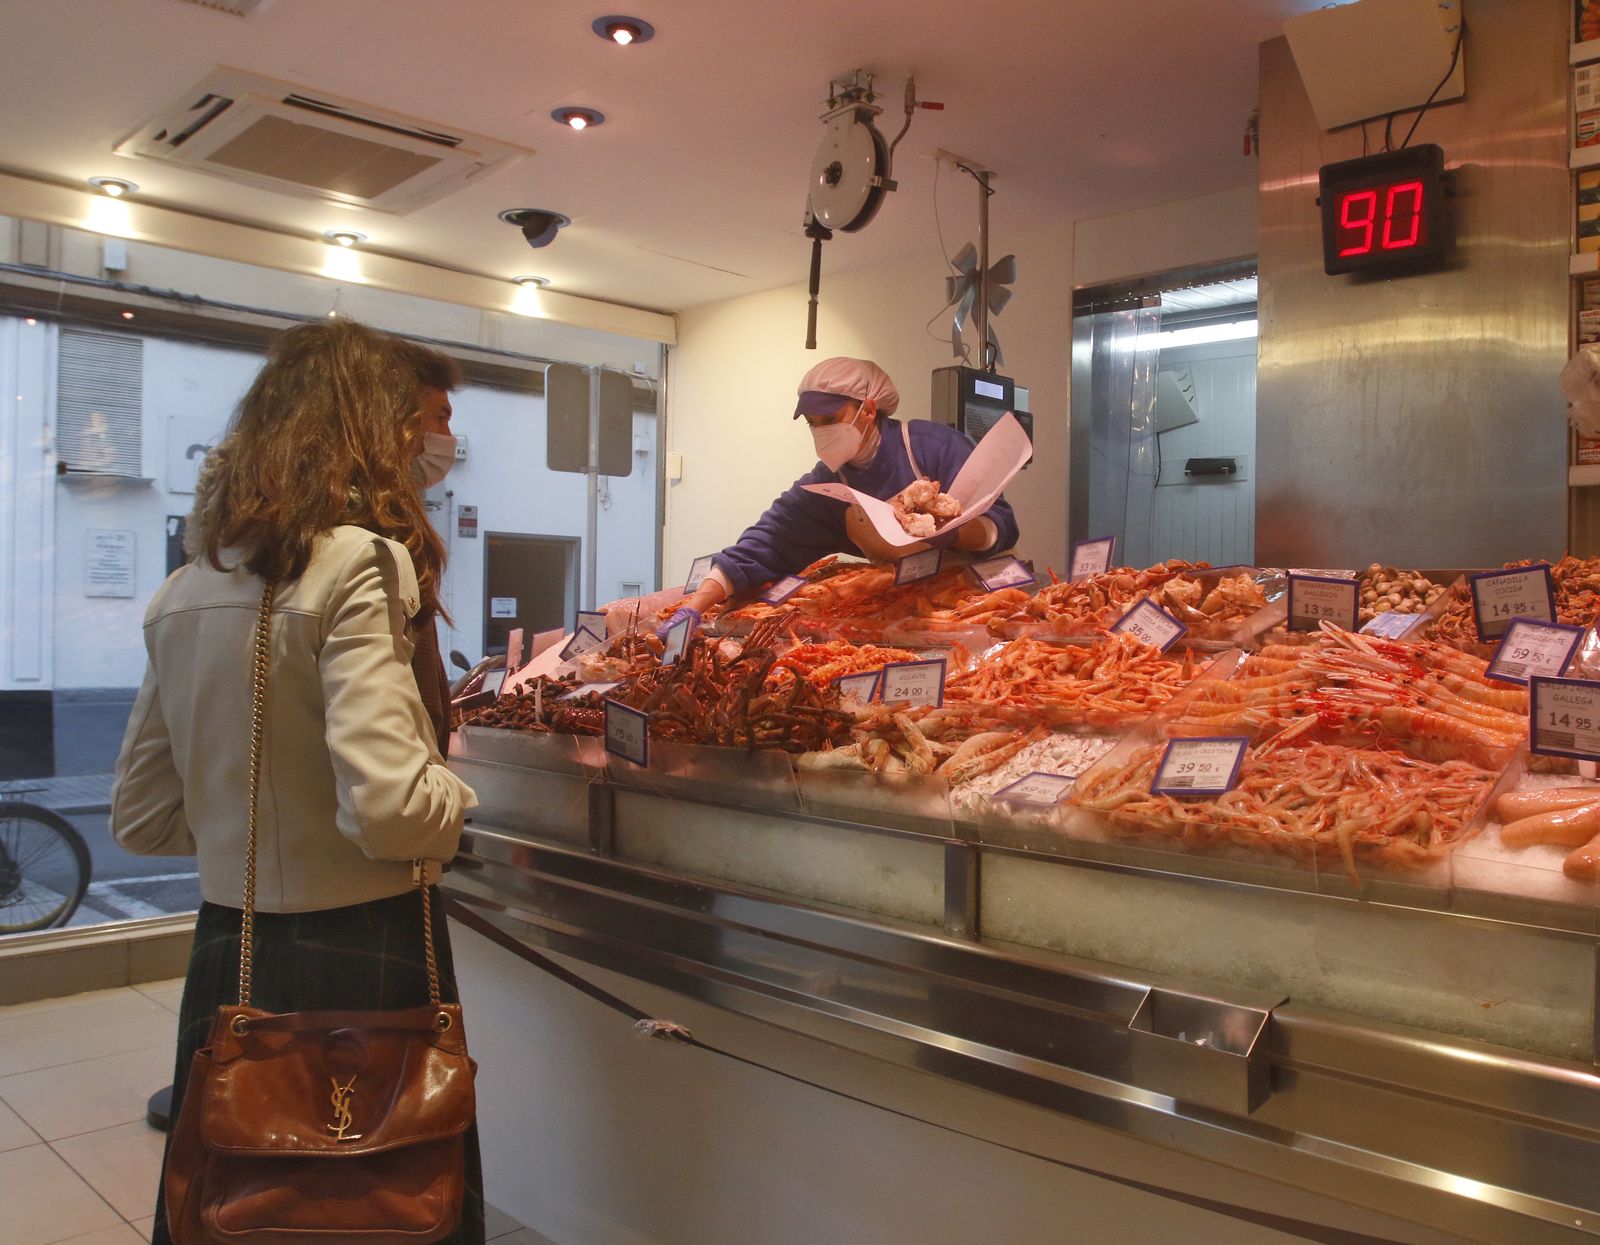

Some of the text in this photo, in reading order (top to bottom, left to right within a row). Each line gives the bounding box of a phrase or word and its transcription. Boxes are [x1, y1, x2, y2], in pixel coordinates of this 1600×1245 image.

[1340, 181, 1423, 257] 90
[1486, 575, 1529, 587] CAÑADILLA
[1495, 586, 1523, 595] COCIDA
[1552, 694, 1594, 705] GALLEGA
